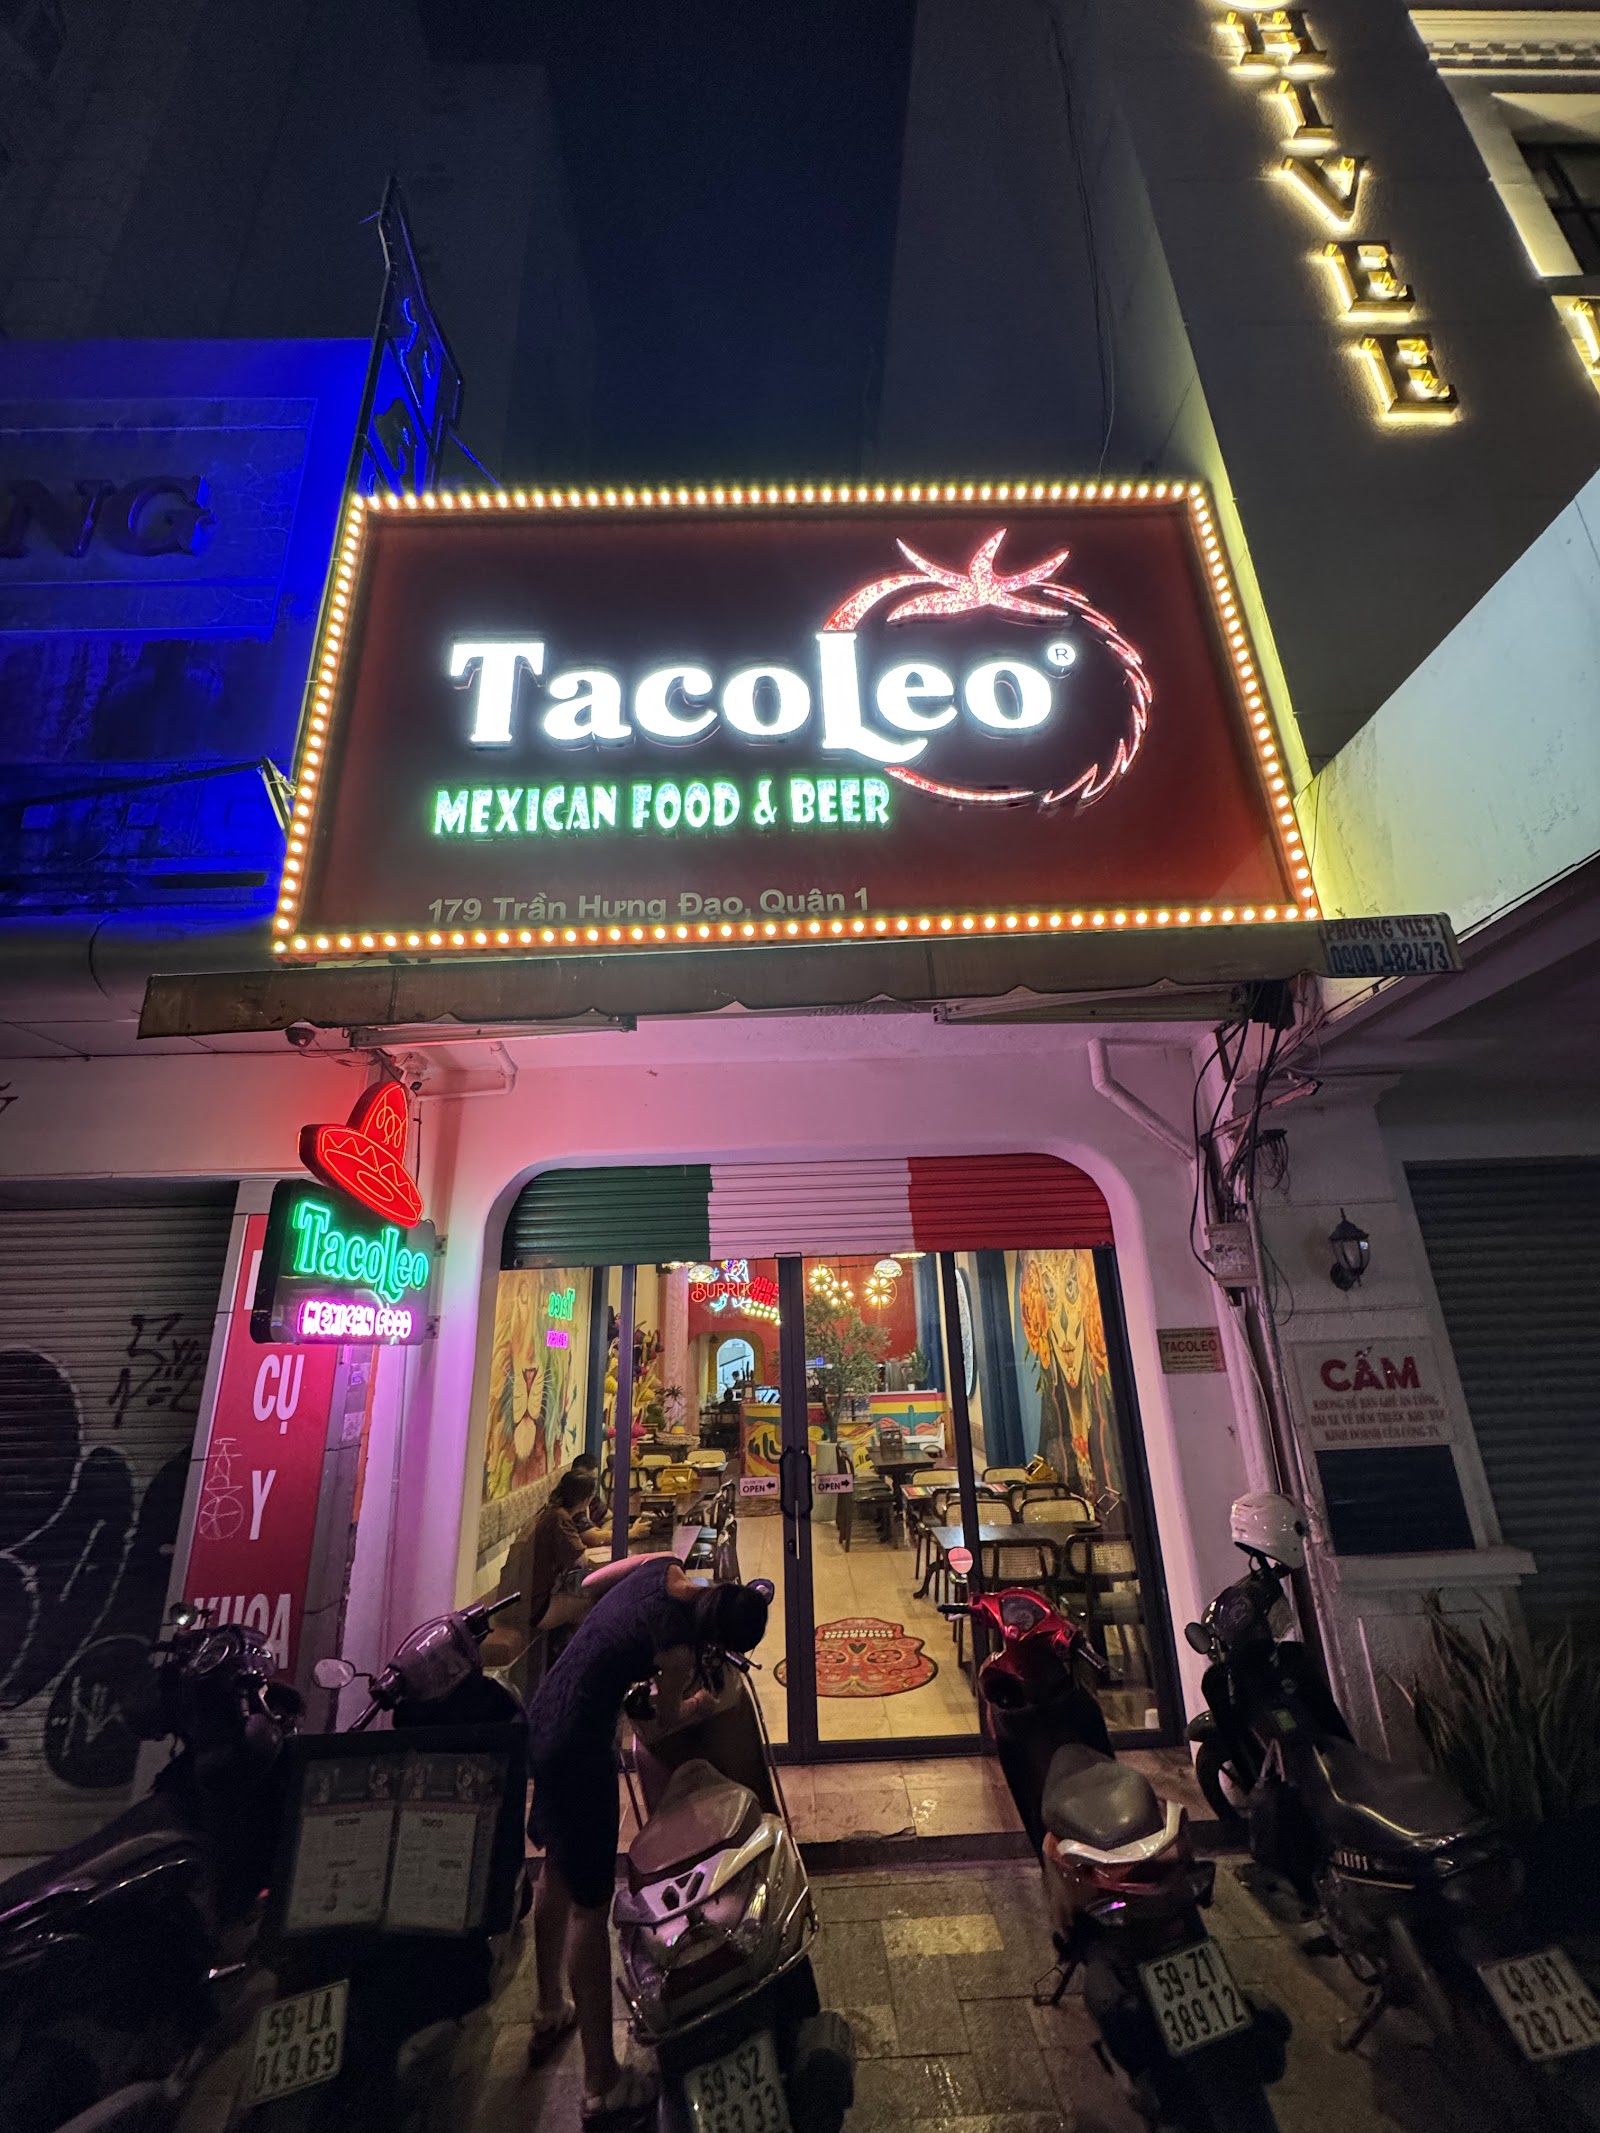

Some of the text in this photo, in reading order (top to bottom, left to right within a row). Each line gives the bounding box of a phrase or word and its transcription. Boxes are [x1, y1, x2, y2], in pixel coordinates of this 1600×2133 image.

[450, 632, 1053, 763] TacoLeo
[433, 777, 890, 835] MEXICAN FOOD & BEER
[428, 887, 868, 923] 179 Trần Hưng Đạo, Quận 1
[293, 1201, 429, 1303] TacoLeo
[754, 1276, 779, 1297] ORDE
[298, 1300, 375, 1336] MEXICAN
[1162, 1340, 1217, 1353] TACOLEO
[1320, 1346, 1421, 1392] CẤM
[253, 1354, 305, 1435] CỤ
[249, 1470, 276, 1540] Y
[742, 1485, 765, 1493] OPEN
[818, 1482, 841, 1491] OPEN
